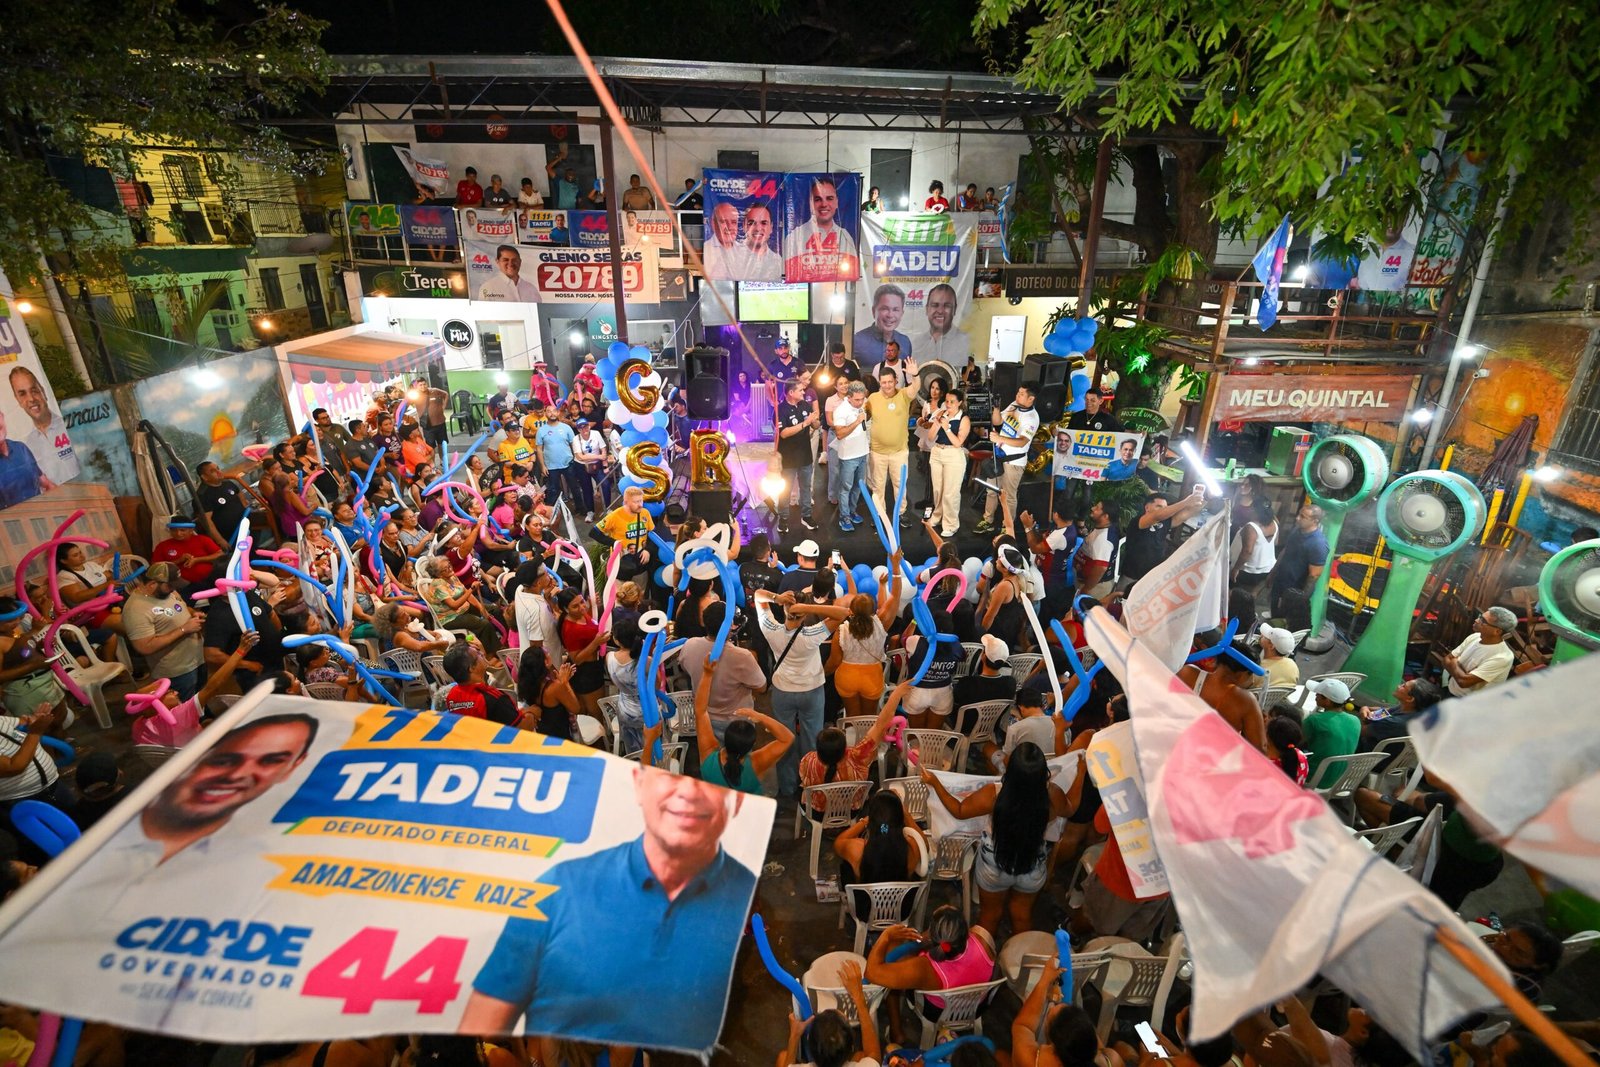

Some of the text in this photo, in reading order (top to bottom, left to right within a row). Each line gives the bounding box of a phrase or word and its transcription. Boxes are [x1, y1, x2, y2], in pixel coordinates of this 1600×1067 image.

[709, 178, 777, 198] CIDADE 44
[410, 225, 447, 236] CIDADE
[478, 224, 512, 234] 20789
[580, 215, 608, 231] 44
[637, 223, 671, 234] 20789
[892, 220, 944, 242] 1111
[578, 231, 609, 241] CIDAD
[472, 254, 490, 264] 44
[539, 252, 591, 263] GLENIO
[876, 250, 958, 272] TADEU
[1385, 255, 1402, 267] 44
[1015, 276, 1052, 289] BOTECO
[1055, 276, 1068, 289] DO
[431, 289, 452, 297] MIX
[907, 289, 924, 300] 44
[450, 330, 470, 342] MIX
[614, 358, 660, 416] G
[1229, 388, 1390, 410] MEU QUINTAL
[54, 432, 70, 448] 44
[689, 429, 732, 484] R
[1077, 445, 1111, 457] TADEU
[625, 441, 671, 502] S
[1082, 468, 1100, 479] 44
[930, 661, 956, 670] UNTOS
[333, 761, 571, 814] TADEU
[322, 819, 532, 852] DEPUTADO FEDERAL
[290, 861, 537, 909] AMAZONENSE RAIZ
[115, 916, 314, 968] CIDADE
[98, 953, 295, 989] GOVERNADOR
[300, 925, 470, 1015] 44
